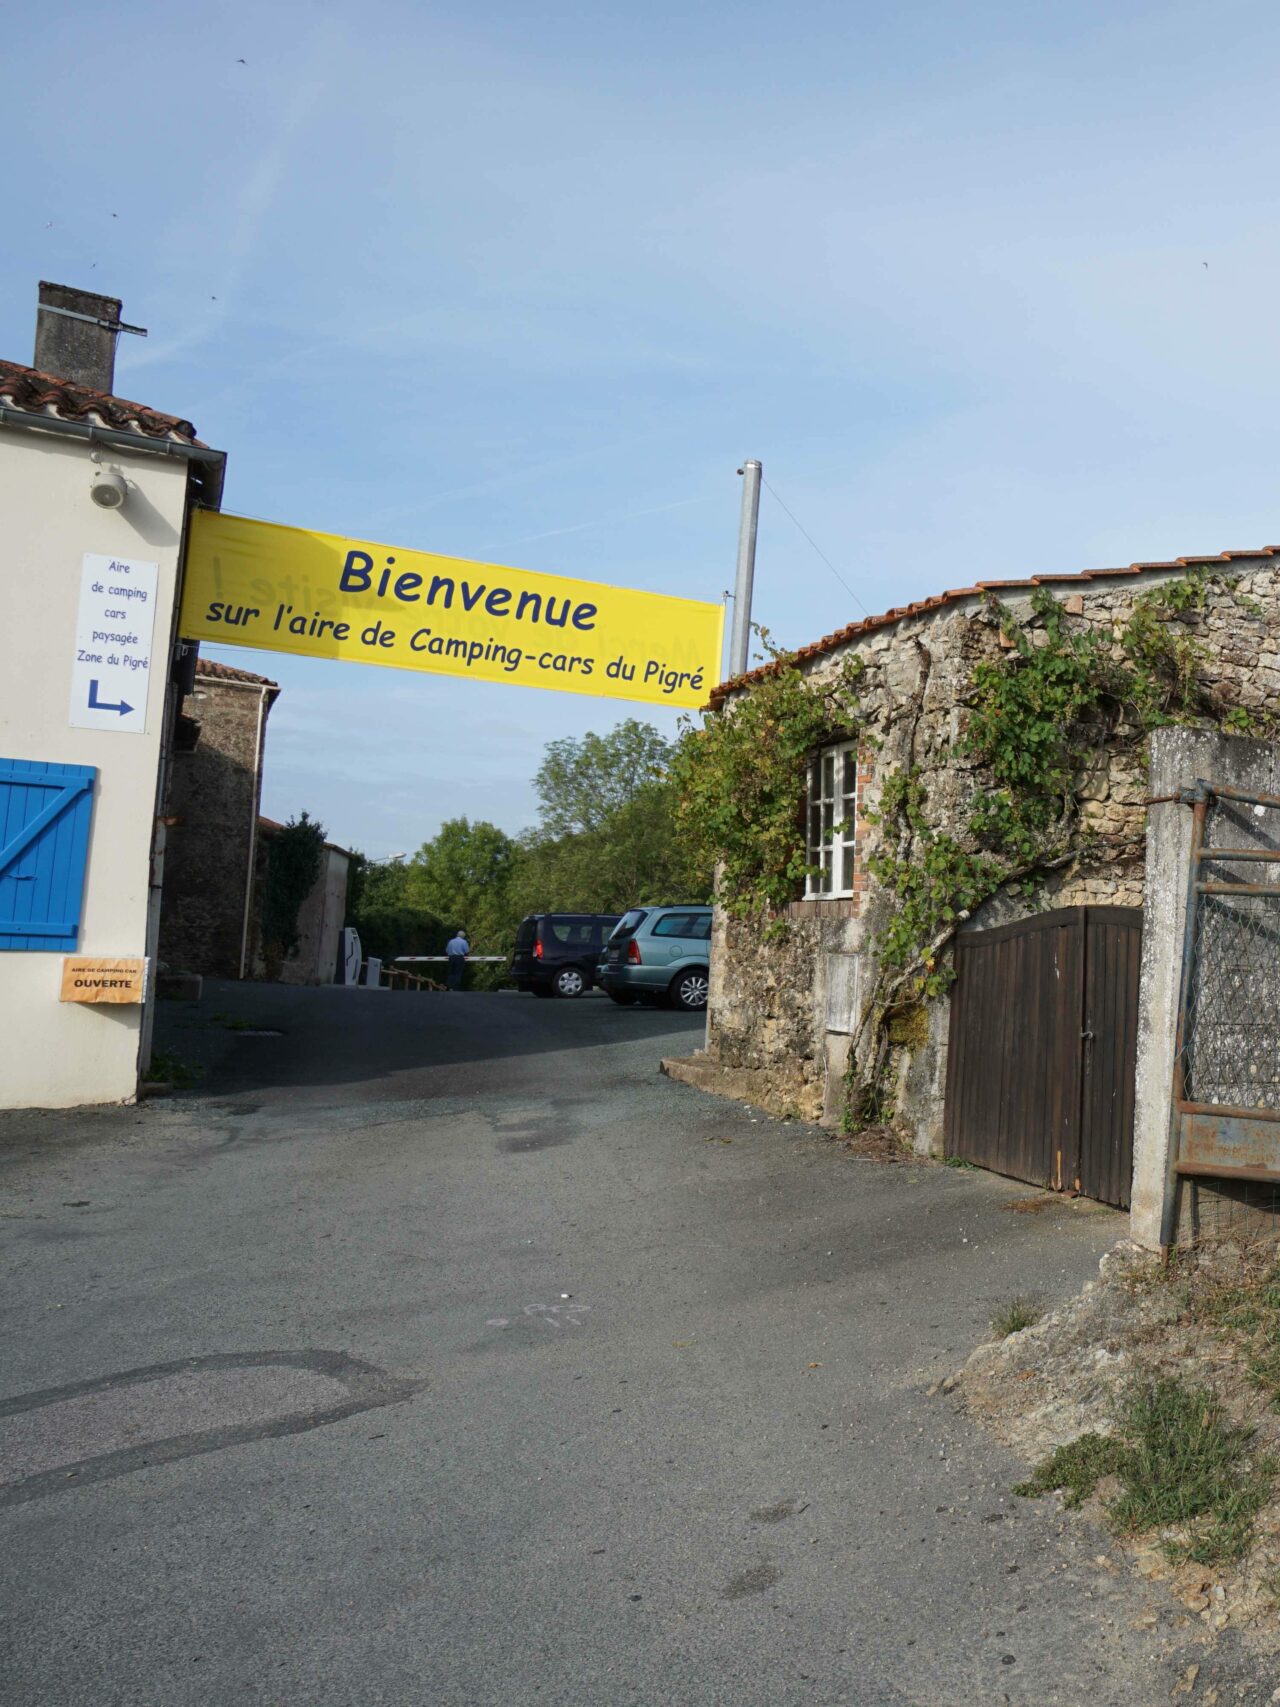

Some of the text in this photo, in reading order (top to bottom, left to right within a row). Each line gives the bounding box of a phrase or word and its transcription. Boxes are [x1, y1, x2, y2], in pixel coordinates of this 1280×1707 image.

[109, 561, 130, 573] Aire
[92, 582, 147, 601] de camping
[339, 550, 597, 631] Bienvenue
[104, 609, 126, 619] cars
[92, 631, 138, 645] paysagée
[206, 602, 705, 694] sur l'aire de Camping-cars du Pigré
[77, 650, 148, 670] Zone du Pigré
[74, 980, 132, 988] OUVERTE
